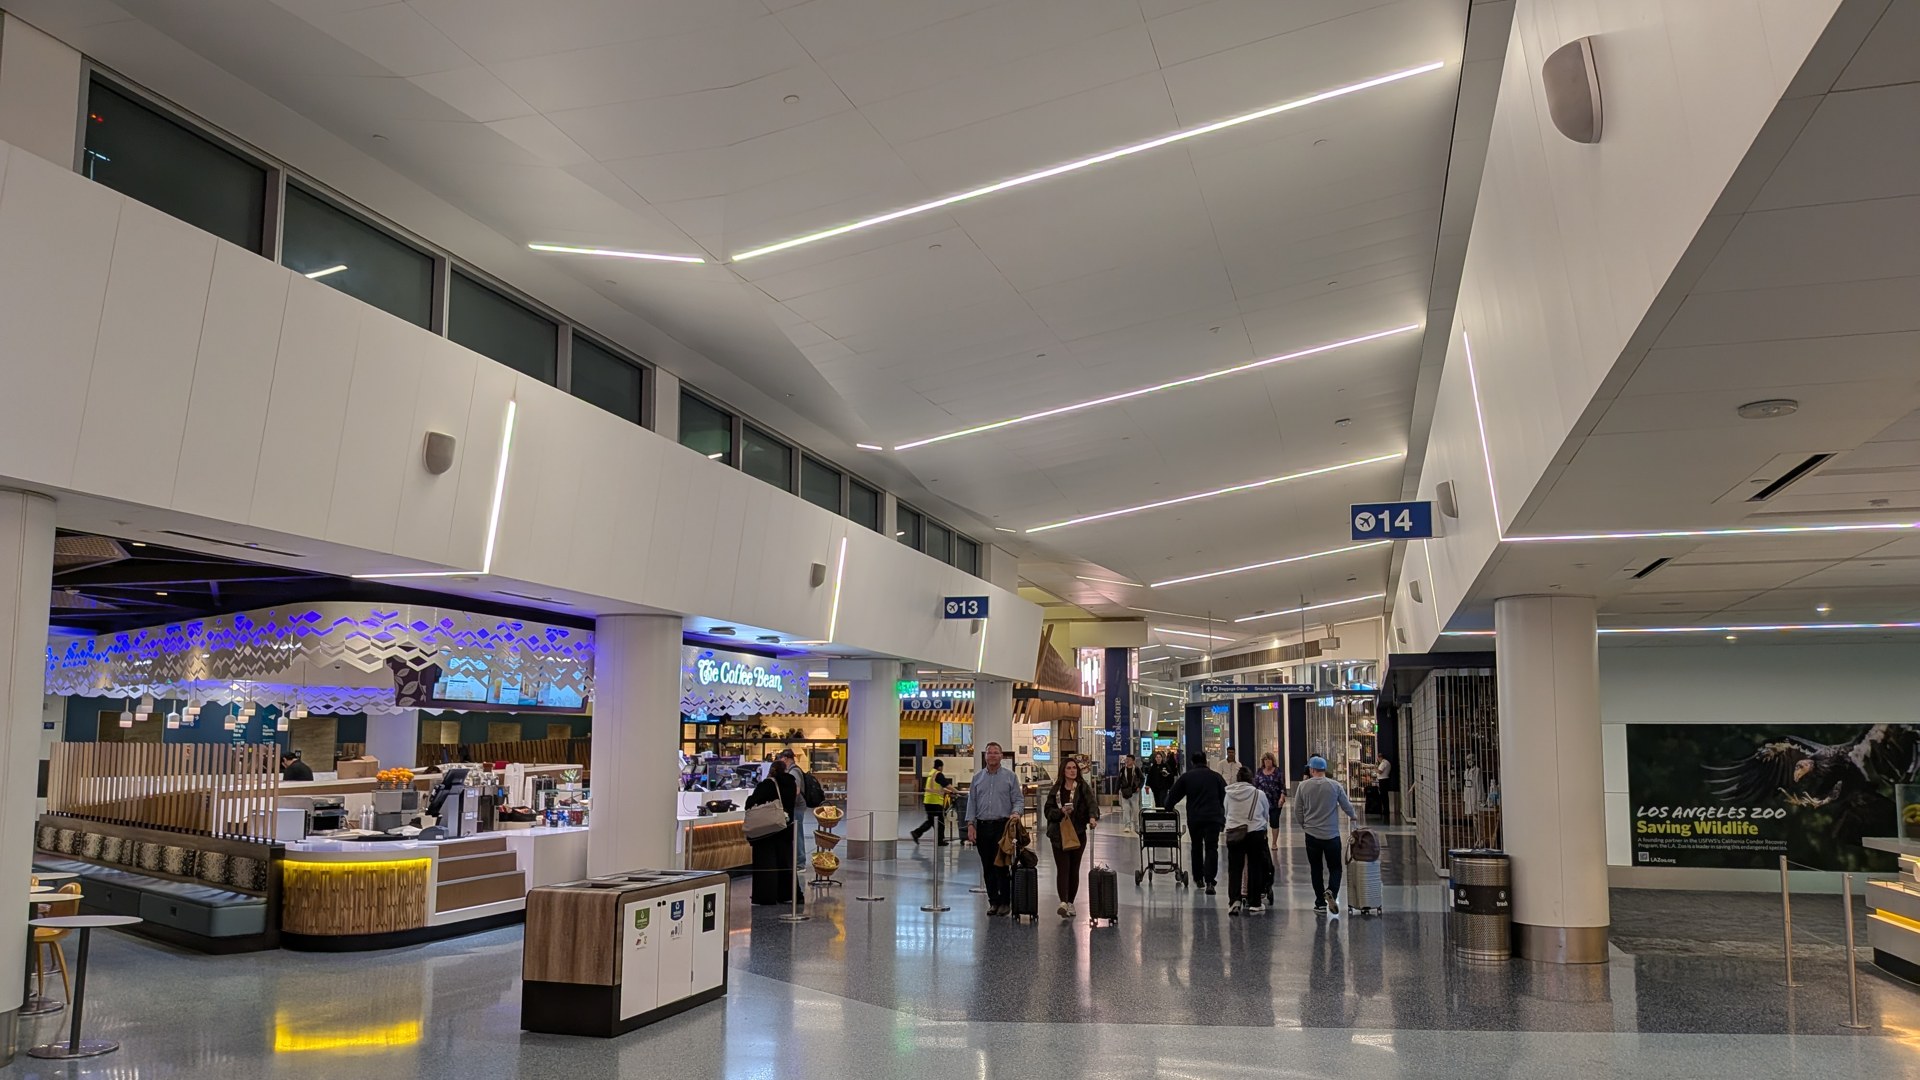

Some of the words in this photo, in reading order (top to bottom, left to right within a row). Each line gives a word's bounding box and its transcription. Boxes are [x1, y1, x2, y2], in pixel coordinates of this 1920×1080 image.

[1378, 508, 1413, 532] 14
[959, 600, 978, 615] 13
[698, 659, 719, 684] The
[720, 661, 753, 686] Coffee
[753, 667, 783, 692] Bean
[1112, 697, 1122, 751] Brookstone
[1636, 806, 1669, 818] LOS
[1671, 806, 1747, 820] ANGELES
[1750, 808, 1787, 819] ZOO
[1637, 820, 1692, 837] Saving
[1694, 820, 1759, 835] Wildlife
